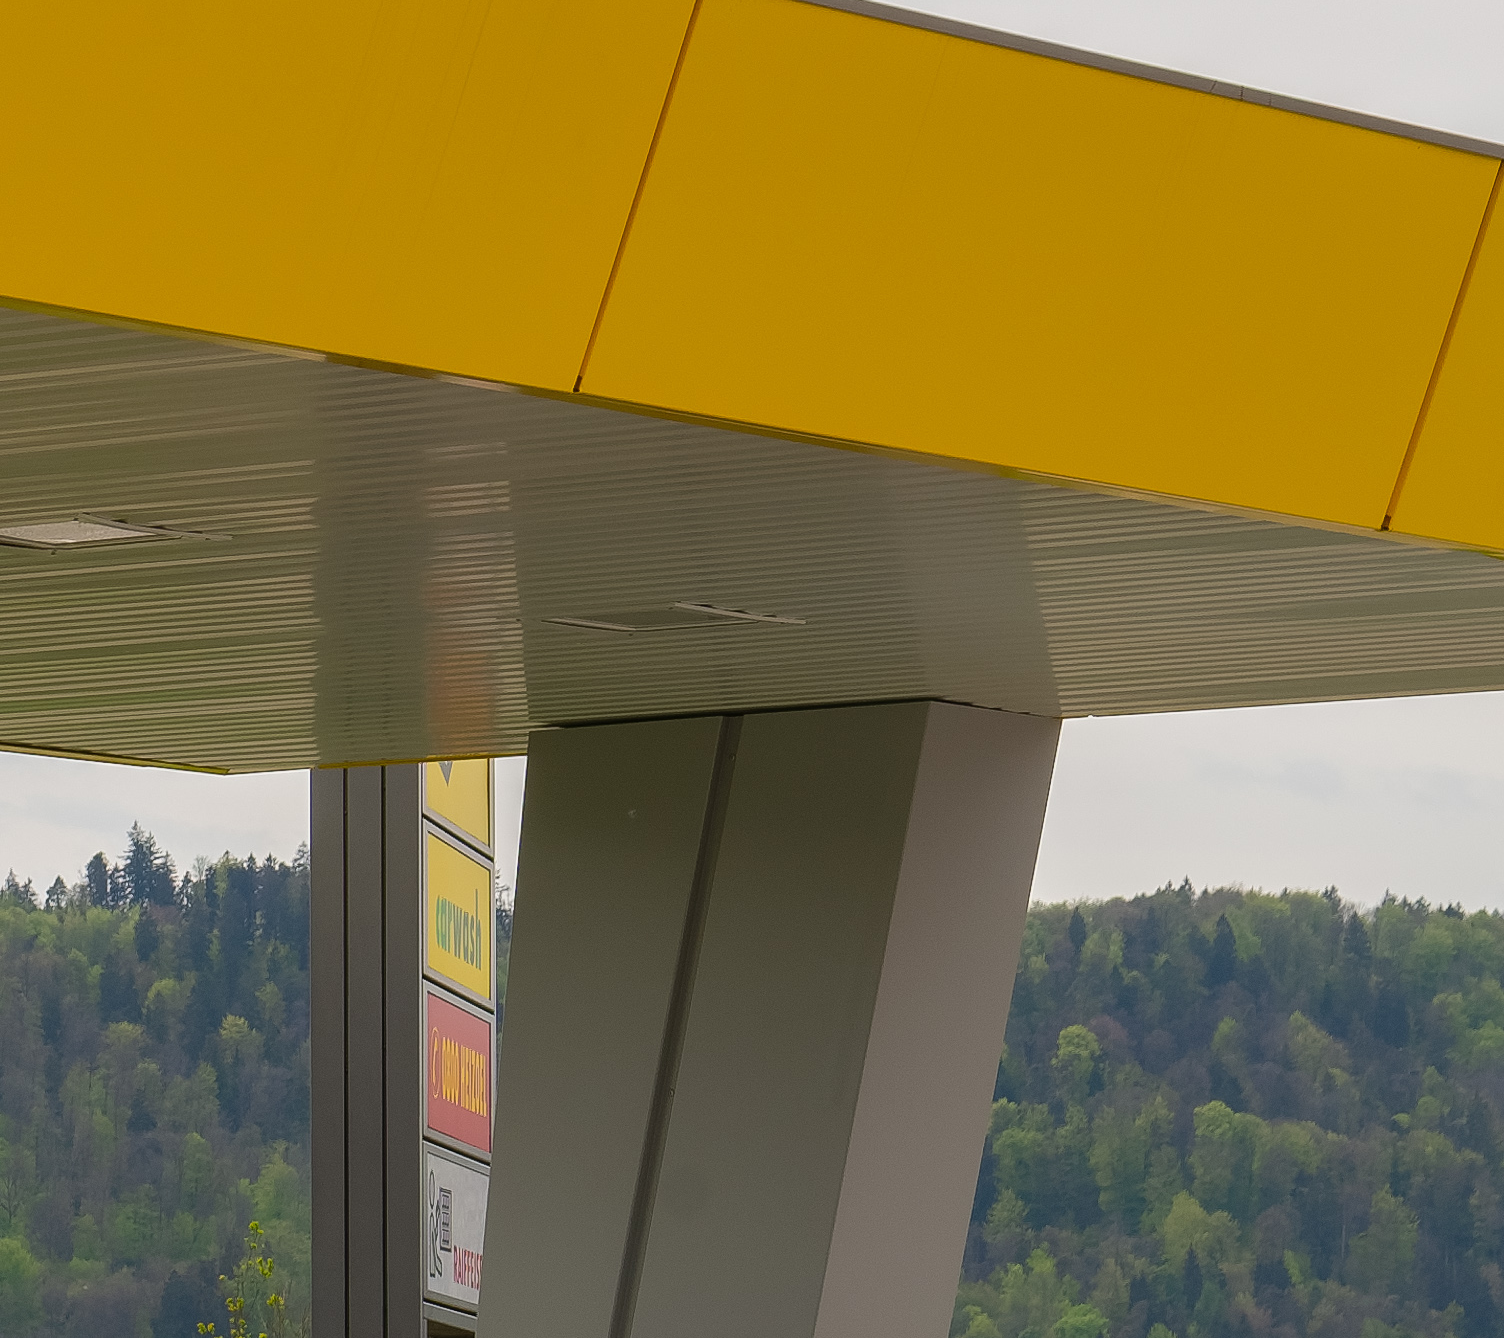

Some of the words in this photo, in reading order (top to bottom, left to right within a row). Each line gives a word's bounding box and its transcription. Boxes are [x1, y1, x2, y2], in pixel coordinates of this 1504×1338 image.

[436, 888, 482, 971] carwash
[442, 1036, 459, 1107] 0800
[460, 1044, 487, 1118] HEIZOEL
